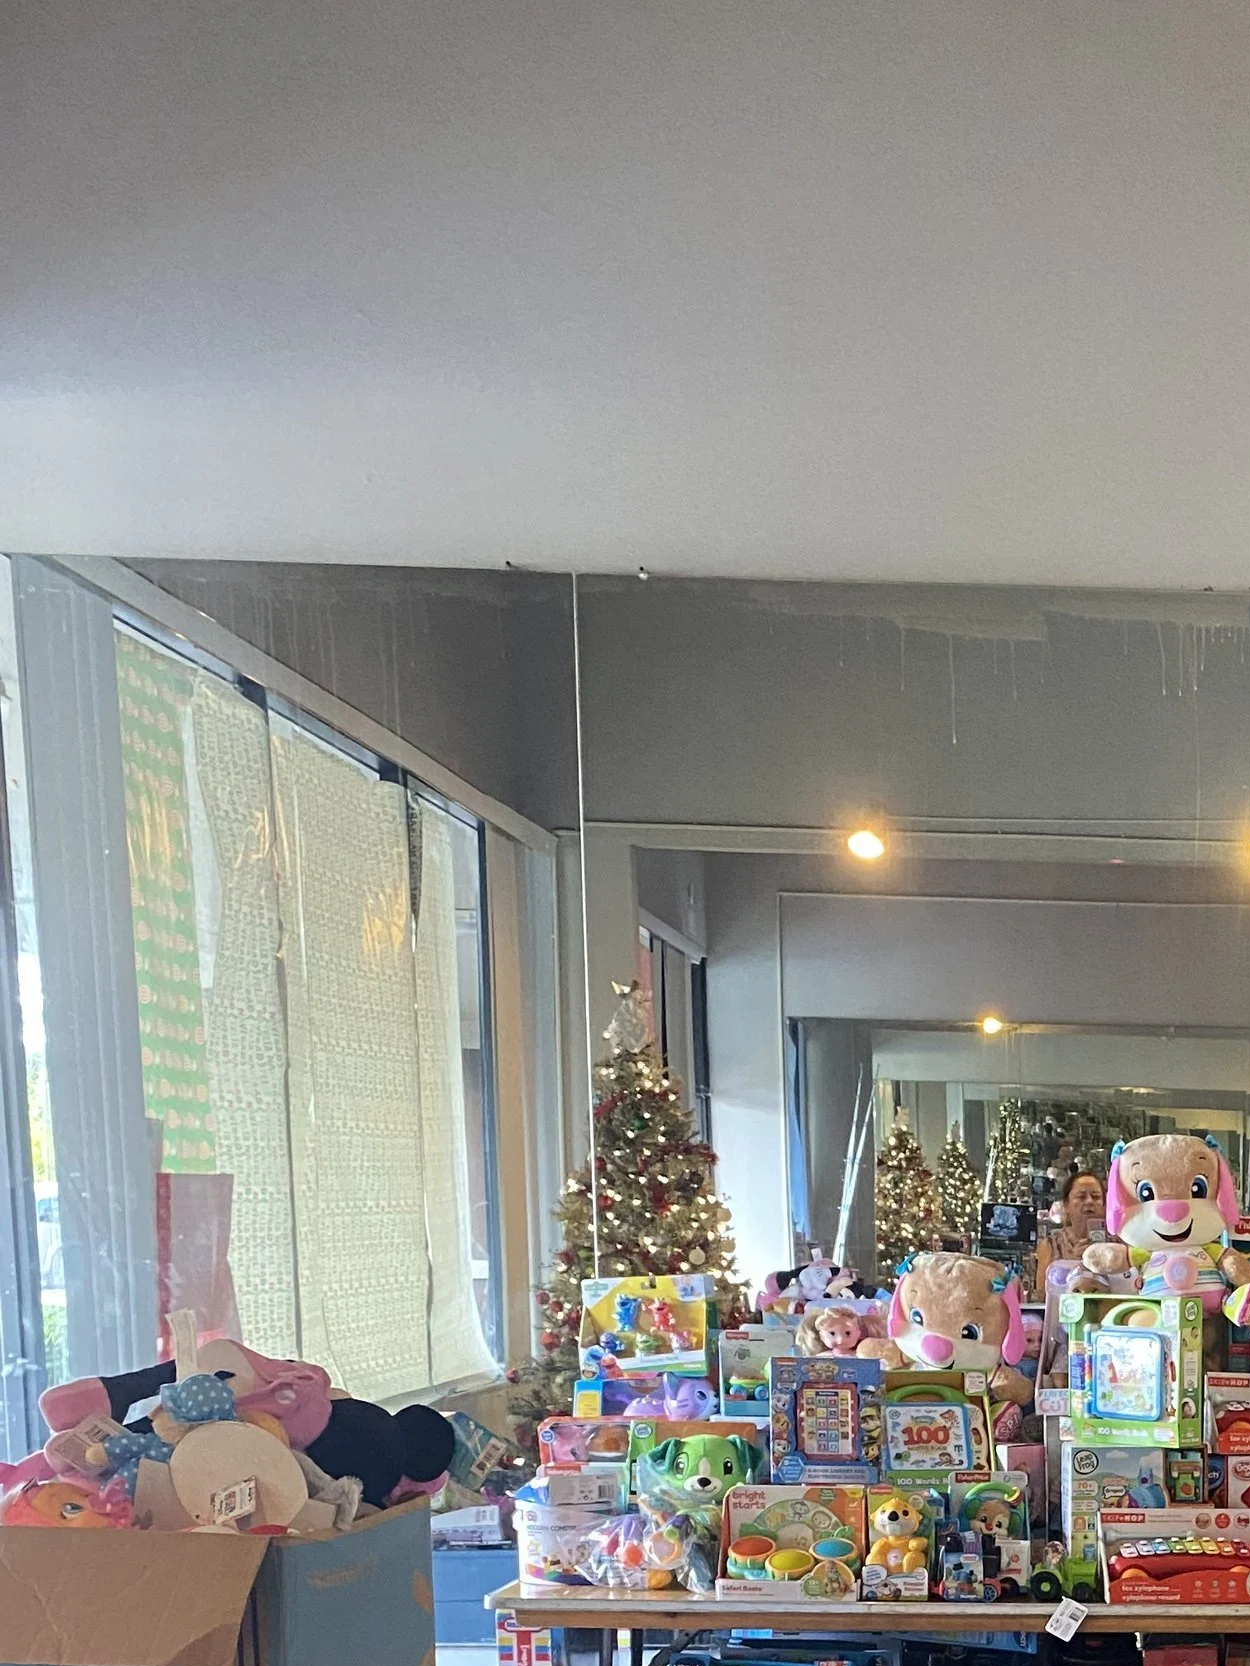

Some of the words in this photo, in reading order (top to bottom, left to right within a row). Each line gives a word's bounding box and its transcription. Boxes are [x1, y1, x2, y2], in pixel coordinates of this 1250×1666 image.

[902, 1424, 950, 1446] 100
[1097, 1428, 1110, 1436] 100
[897, 1477, 914, 1486] 100
[915, 1477, 940, 1486] Words
[732, 1491, 767, 1502] bright
[732, 1501, 767, 1510] starts
